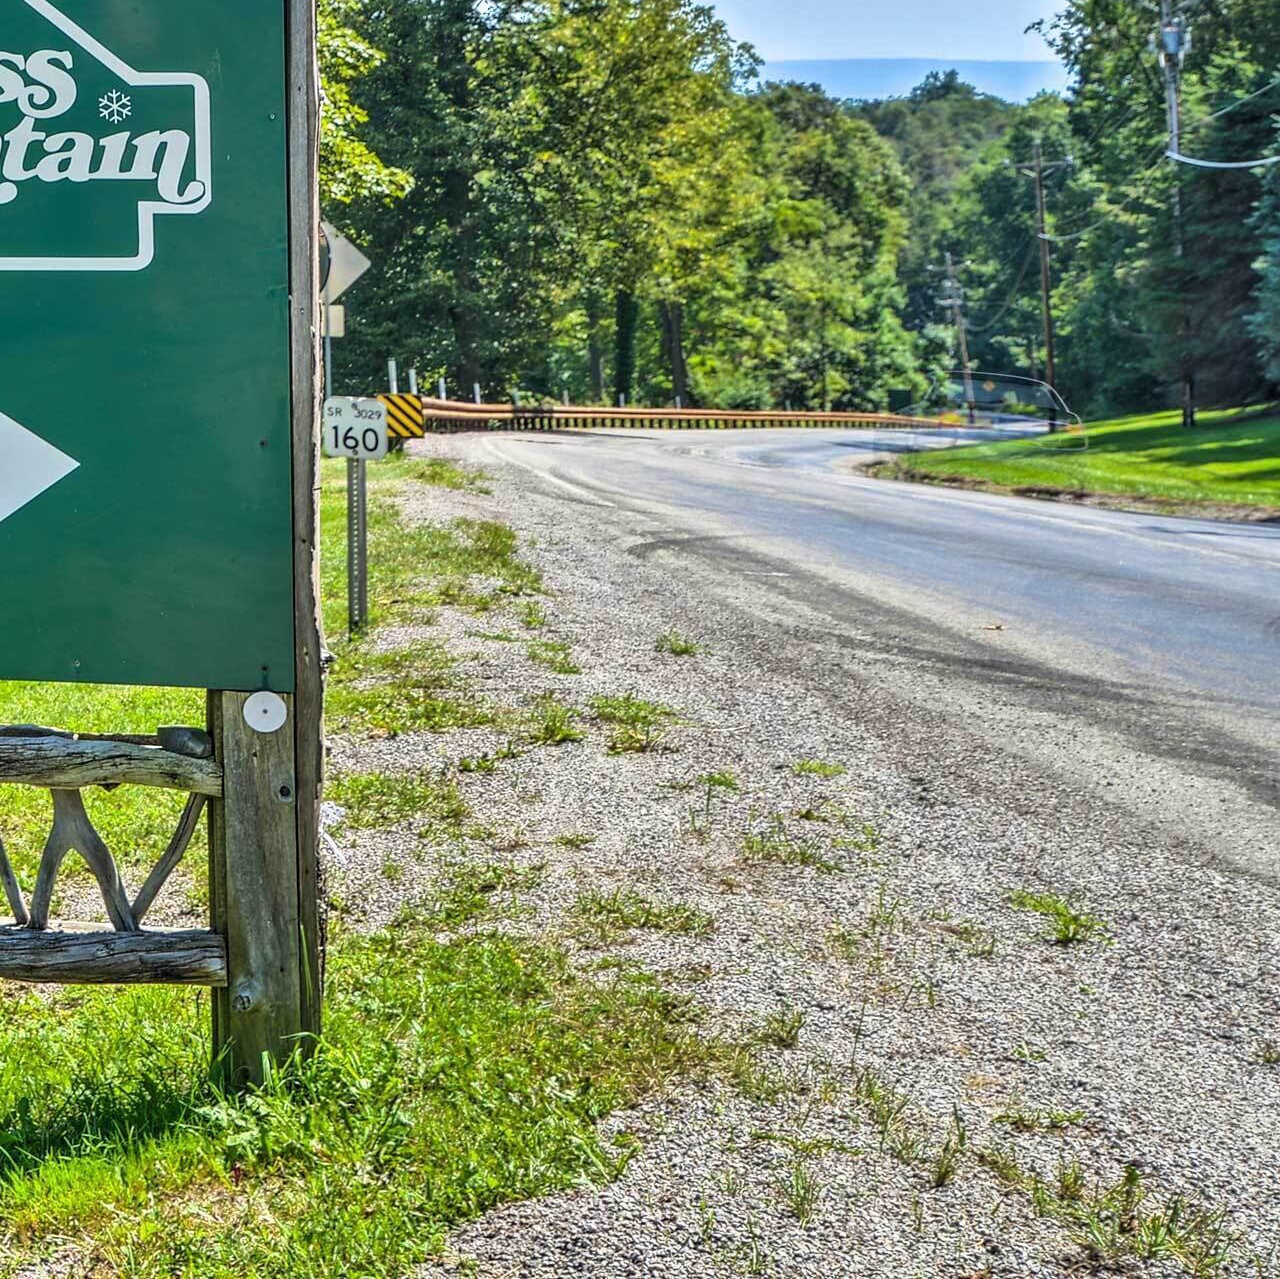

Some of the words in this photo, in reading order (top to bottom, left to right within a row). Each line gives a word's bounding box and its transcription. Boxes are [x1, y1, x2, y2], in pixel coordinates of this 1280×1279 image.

[327, 406, 342, 417] SR
[354, 407, 382, 420] 3029
[331, 425, 379, 452] 160
